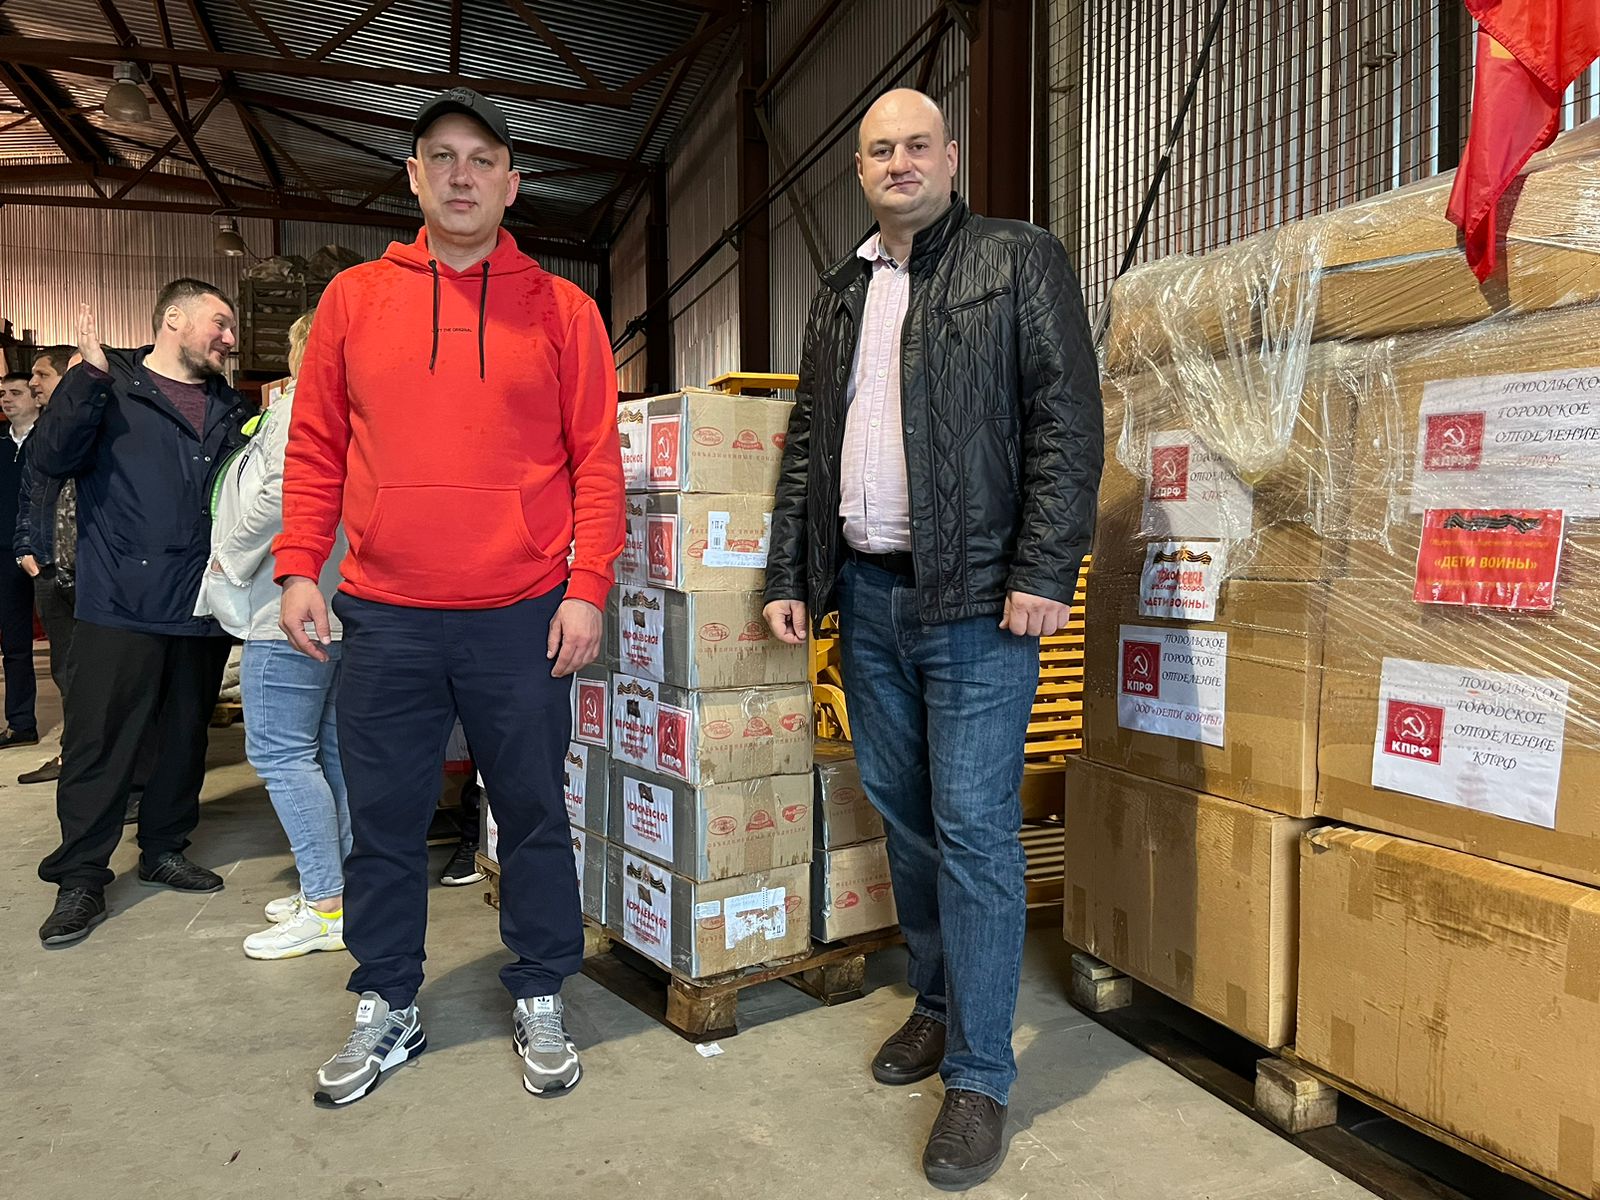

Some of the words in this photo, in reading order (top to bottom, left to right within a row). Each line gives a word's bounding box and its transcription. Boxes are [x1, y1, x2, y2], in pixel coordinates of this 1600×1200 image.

[1502, 376, 1600, 394] ПОДОЛЬСКО
[1498, 401, 1591, 418] ГОРОДСКОЕ
[1495, 426, 1600, 443] ОТДЕЛЕНИЕ
[653, 466, 673, 478] КПРФ
[1164, 634, 1225, 649] ПОДОЛЬСКОЕ
[1163, 652, 1215, 667] ГОРОДСКОЕ
[1126, 680, 1154, 692] КПРФ
[1162, 670, 1221, 687] ОТДЕЛЕНИЕ
[1458, 675, 1565, 702] ПОДОЛЬСКОЕ
[1456, 700, 1547, 725] ГОРОДСКОЕ
[582, 722, 600, 735] КПРФ
[1453, 724, 1556, 752] ОТДЕЛЕНИЕ
[1391, 740, 1433, 758] КПРФ
[661, 752, 682, 769] КПРФ
[1472, 751, 1517, 770] КПРФ
